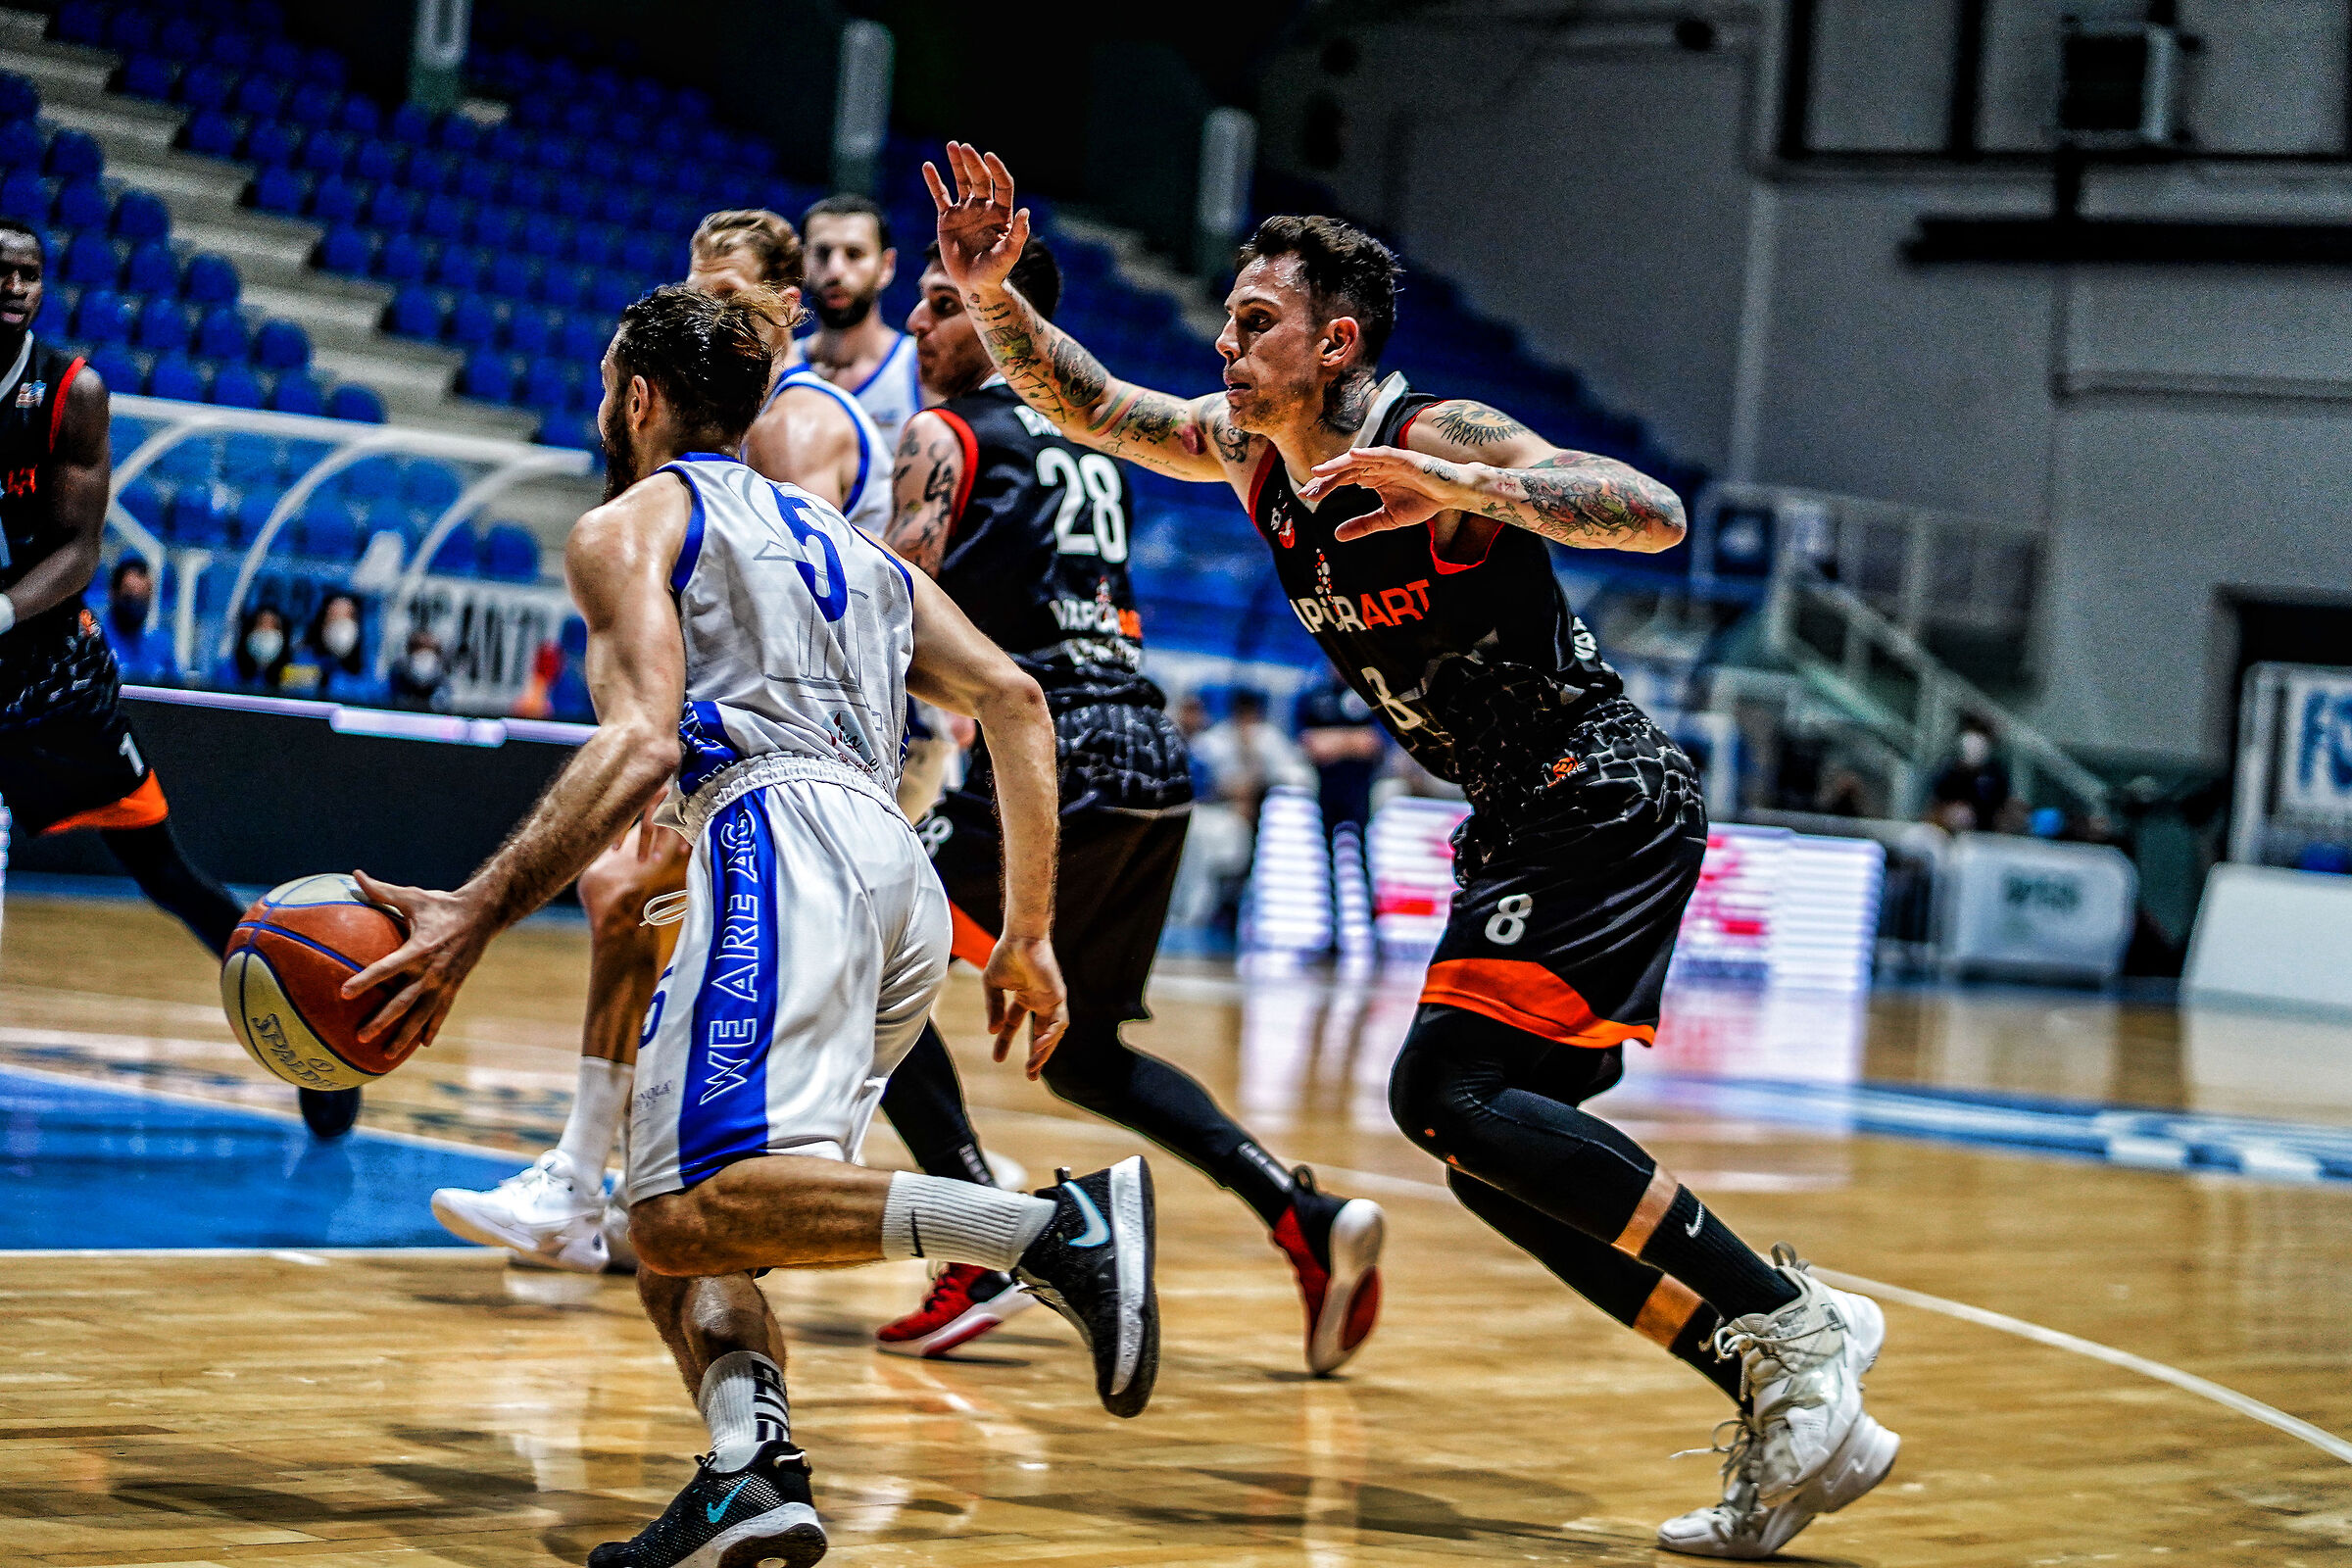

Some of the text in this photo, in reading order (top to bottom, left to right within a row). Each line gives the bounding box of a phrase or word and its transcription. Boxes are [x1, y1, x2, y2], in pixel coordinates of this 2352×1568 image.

[765, 481, 848, 622] 5
[1035, 446, 1129, 564] 28
[710, 893, 760, 1003] ARE
[1485, 893, 1533, 945] 8
[699, 1017, 758, 1105] WE
